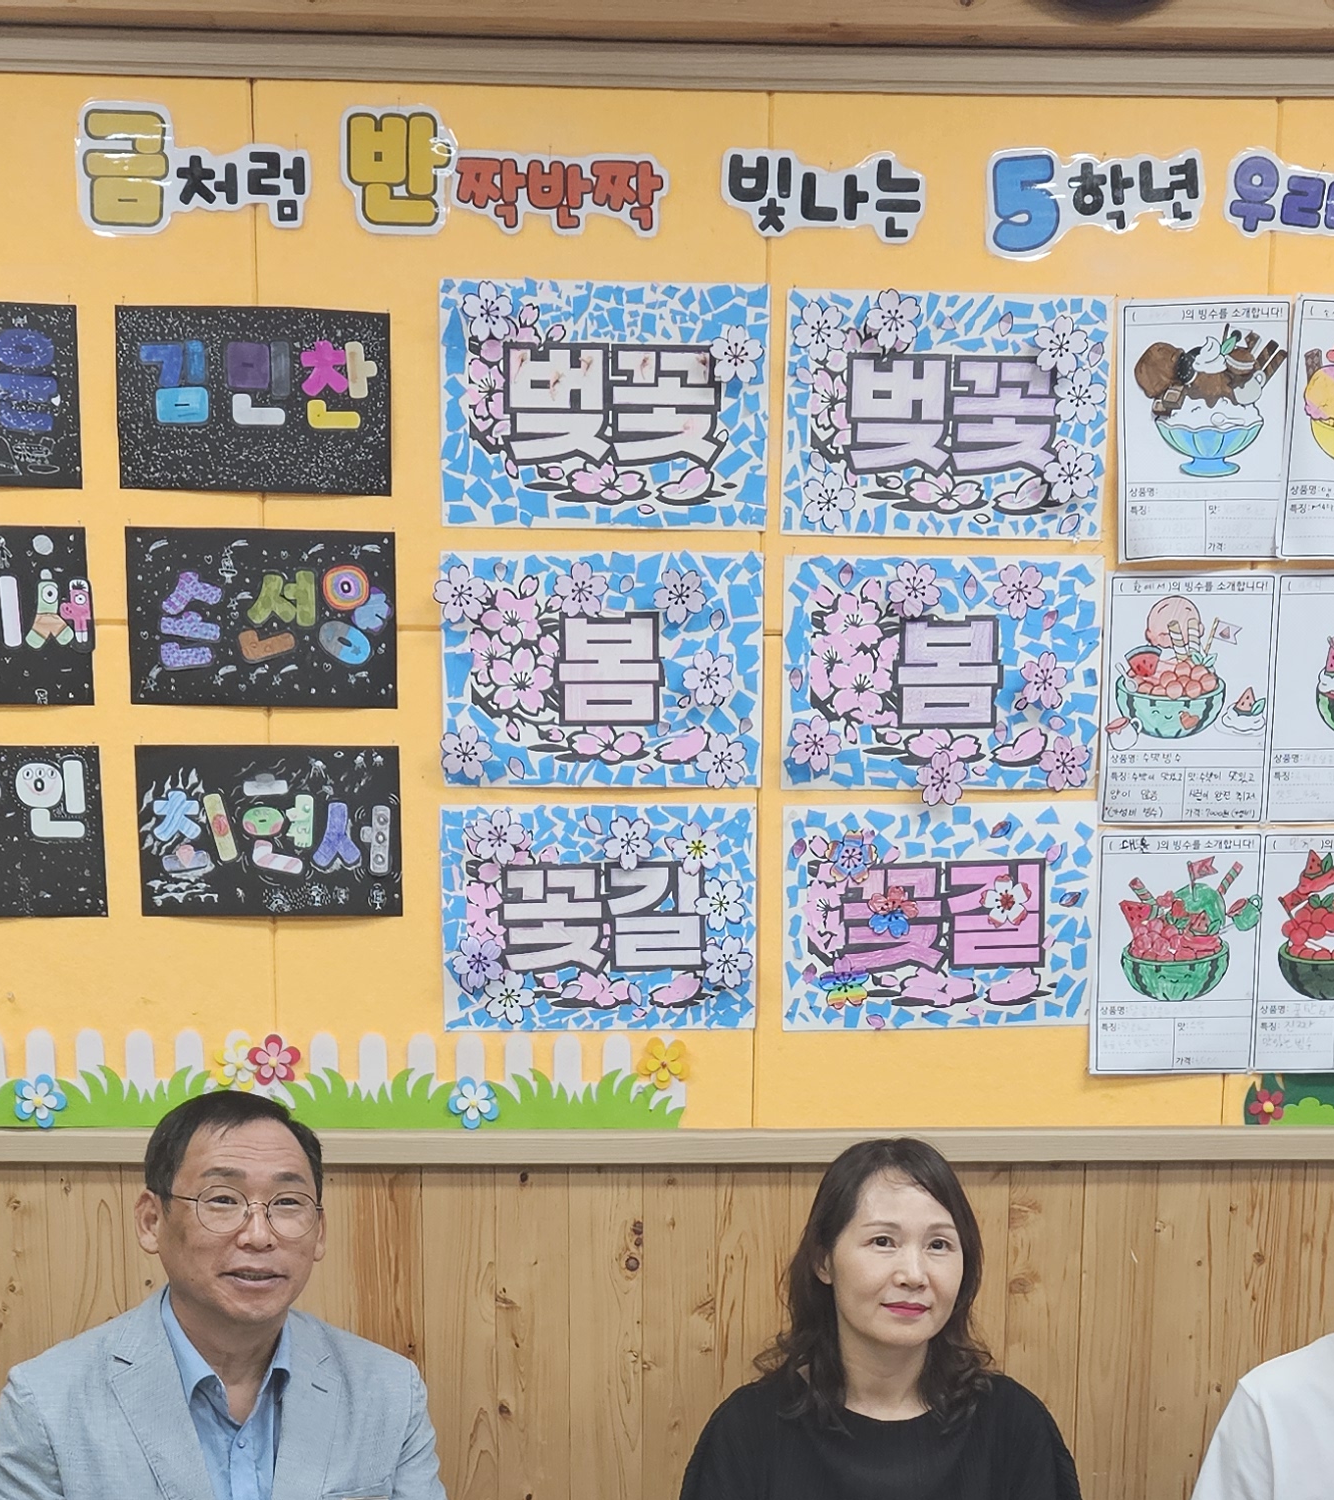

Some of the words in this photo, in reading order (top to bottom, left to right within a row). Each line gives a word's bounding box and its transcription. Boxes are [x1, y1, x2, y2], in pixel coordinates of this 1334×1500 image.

[84, 108, 305, 227] 금처럼
[347, 111, 663, 231] 반짝반짝
[728, 153, 921, 239] 빛나는
[993, 155, 1199, 252] 5학년
[1198, 308, 1228, 320] 빙수를
[1231, 306, 1283, 319] 소개합니다!
[139, 340, 378, 429] 김민찬
[1184, 580, 1213, 592] 빙수를
[1217, 580, 1268, 592] 소개합니다!
[557, 611, 664, 726] 봄
[895, 614, 1004, 729] 봄
[1173, 839, 1201, 851] 빙수를
[1204, 838, 1255, 850] 소개합니다!
